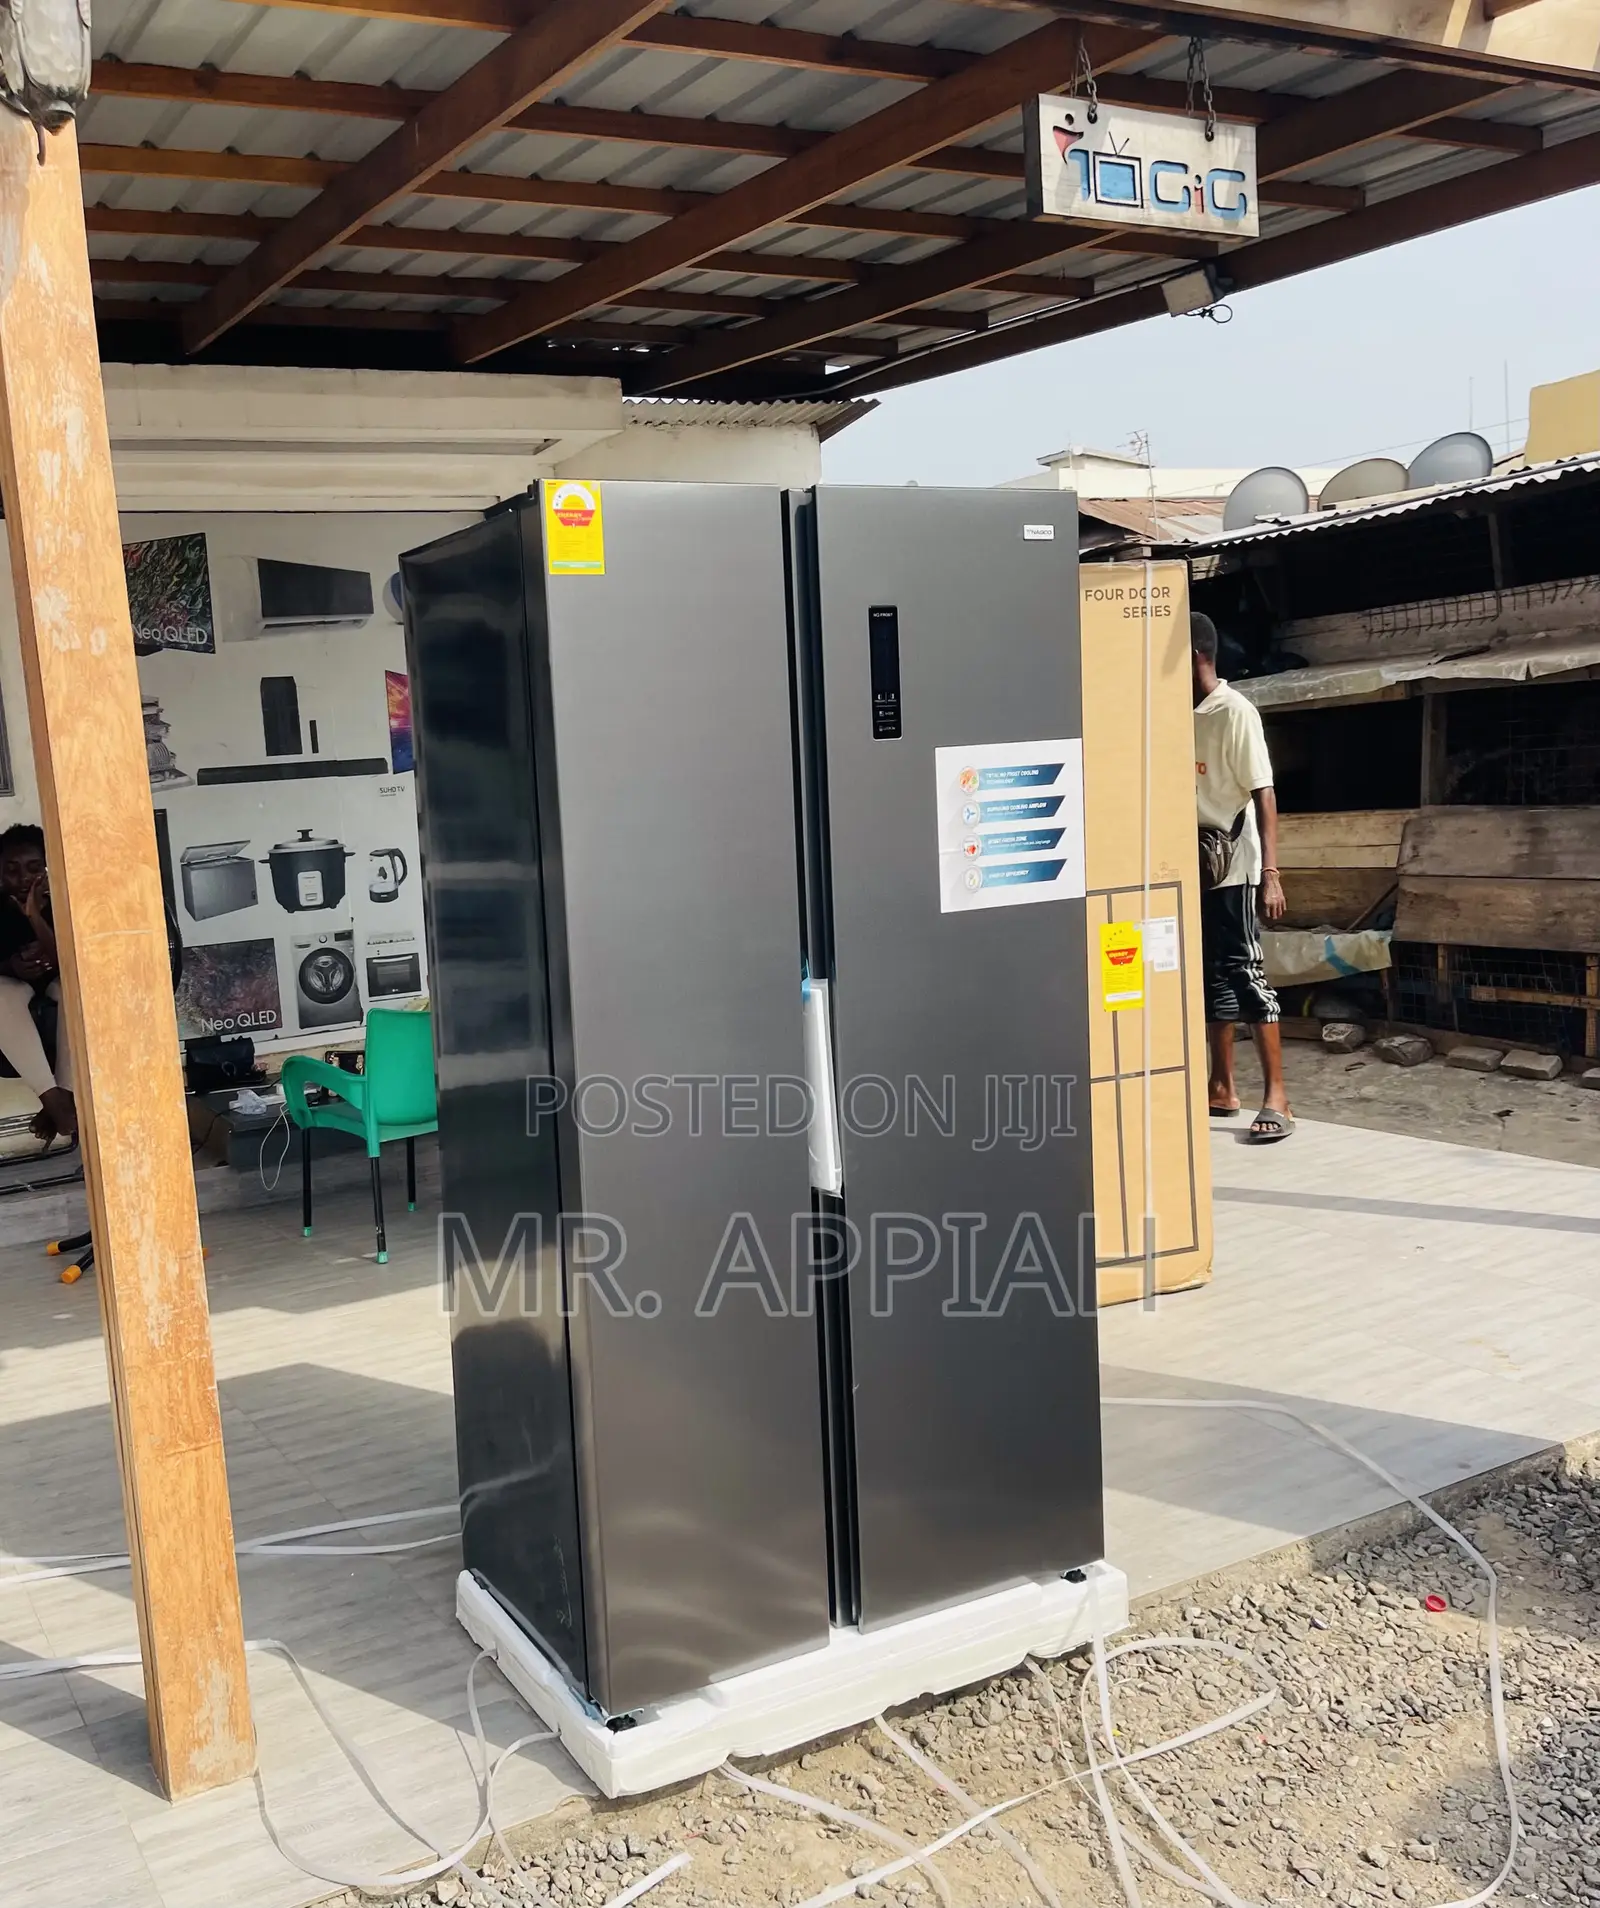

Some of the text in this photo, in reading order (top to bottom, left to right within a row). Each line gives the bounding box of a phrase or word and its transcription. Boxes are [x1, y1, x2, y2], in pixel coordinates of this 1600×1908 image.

[1085, 586, 1170, 602] FOUR DOOR
[1123, 605, 1171, 619] SERIES
[132, 623, 208, 645] Neo QLED
[201, 1010, 277, 1033] Neo QLED
